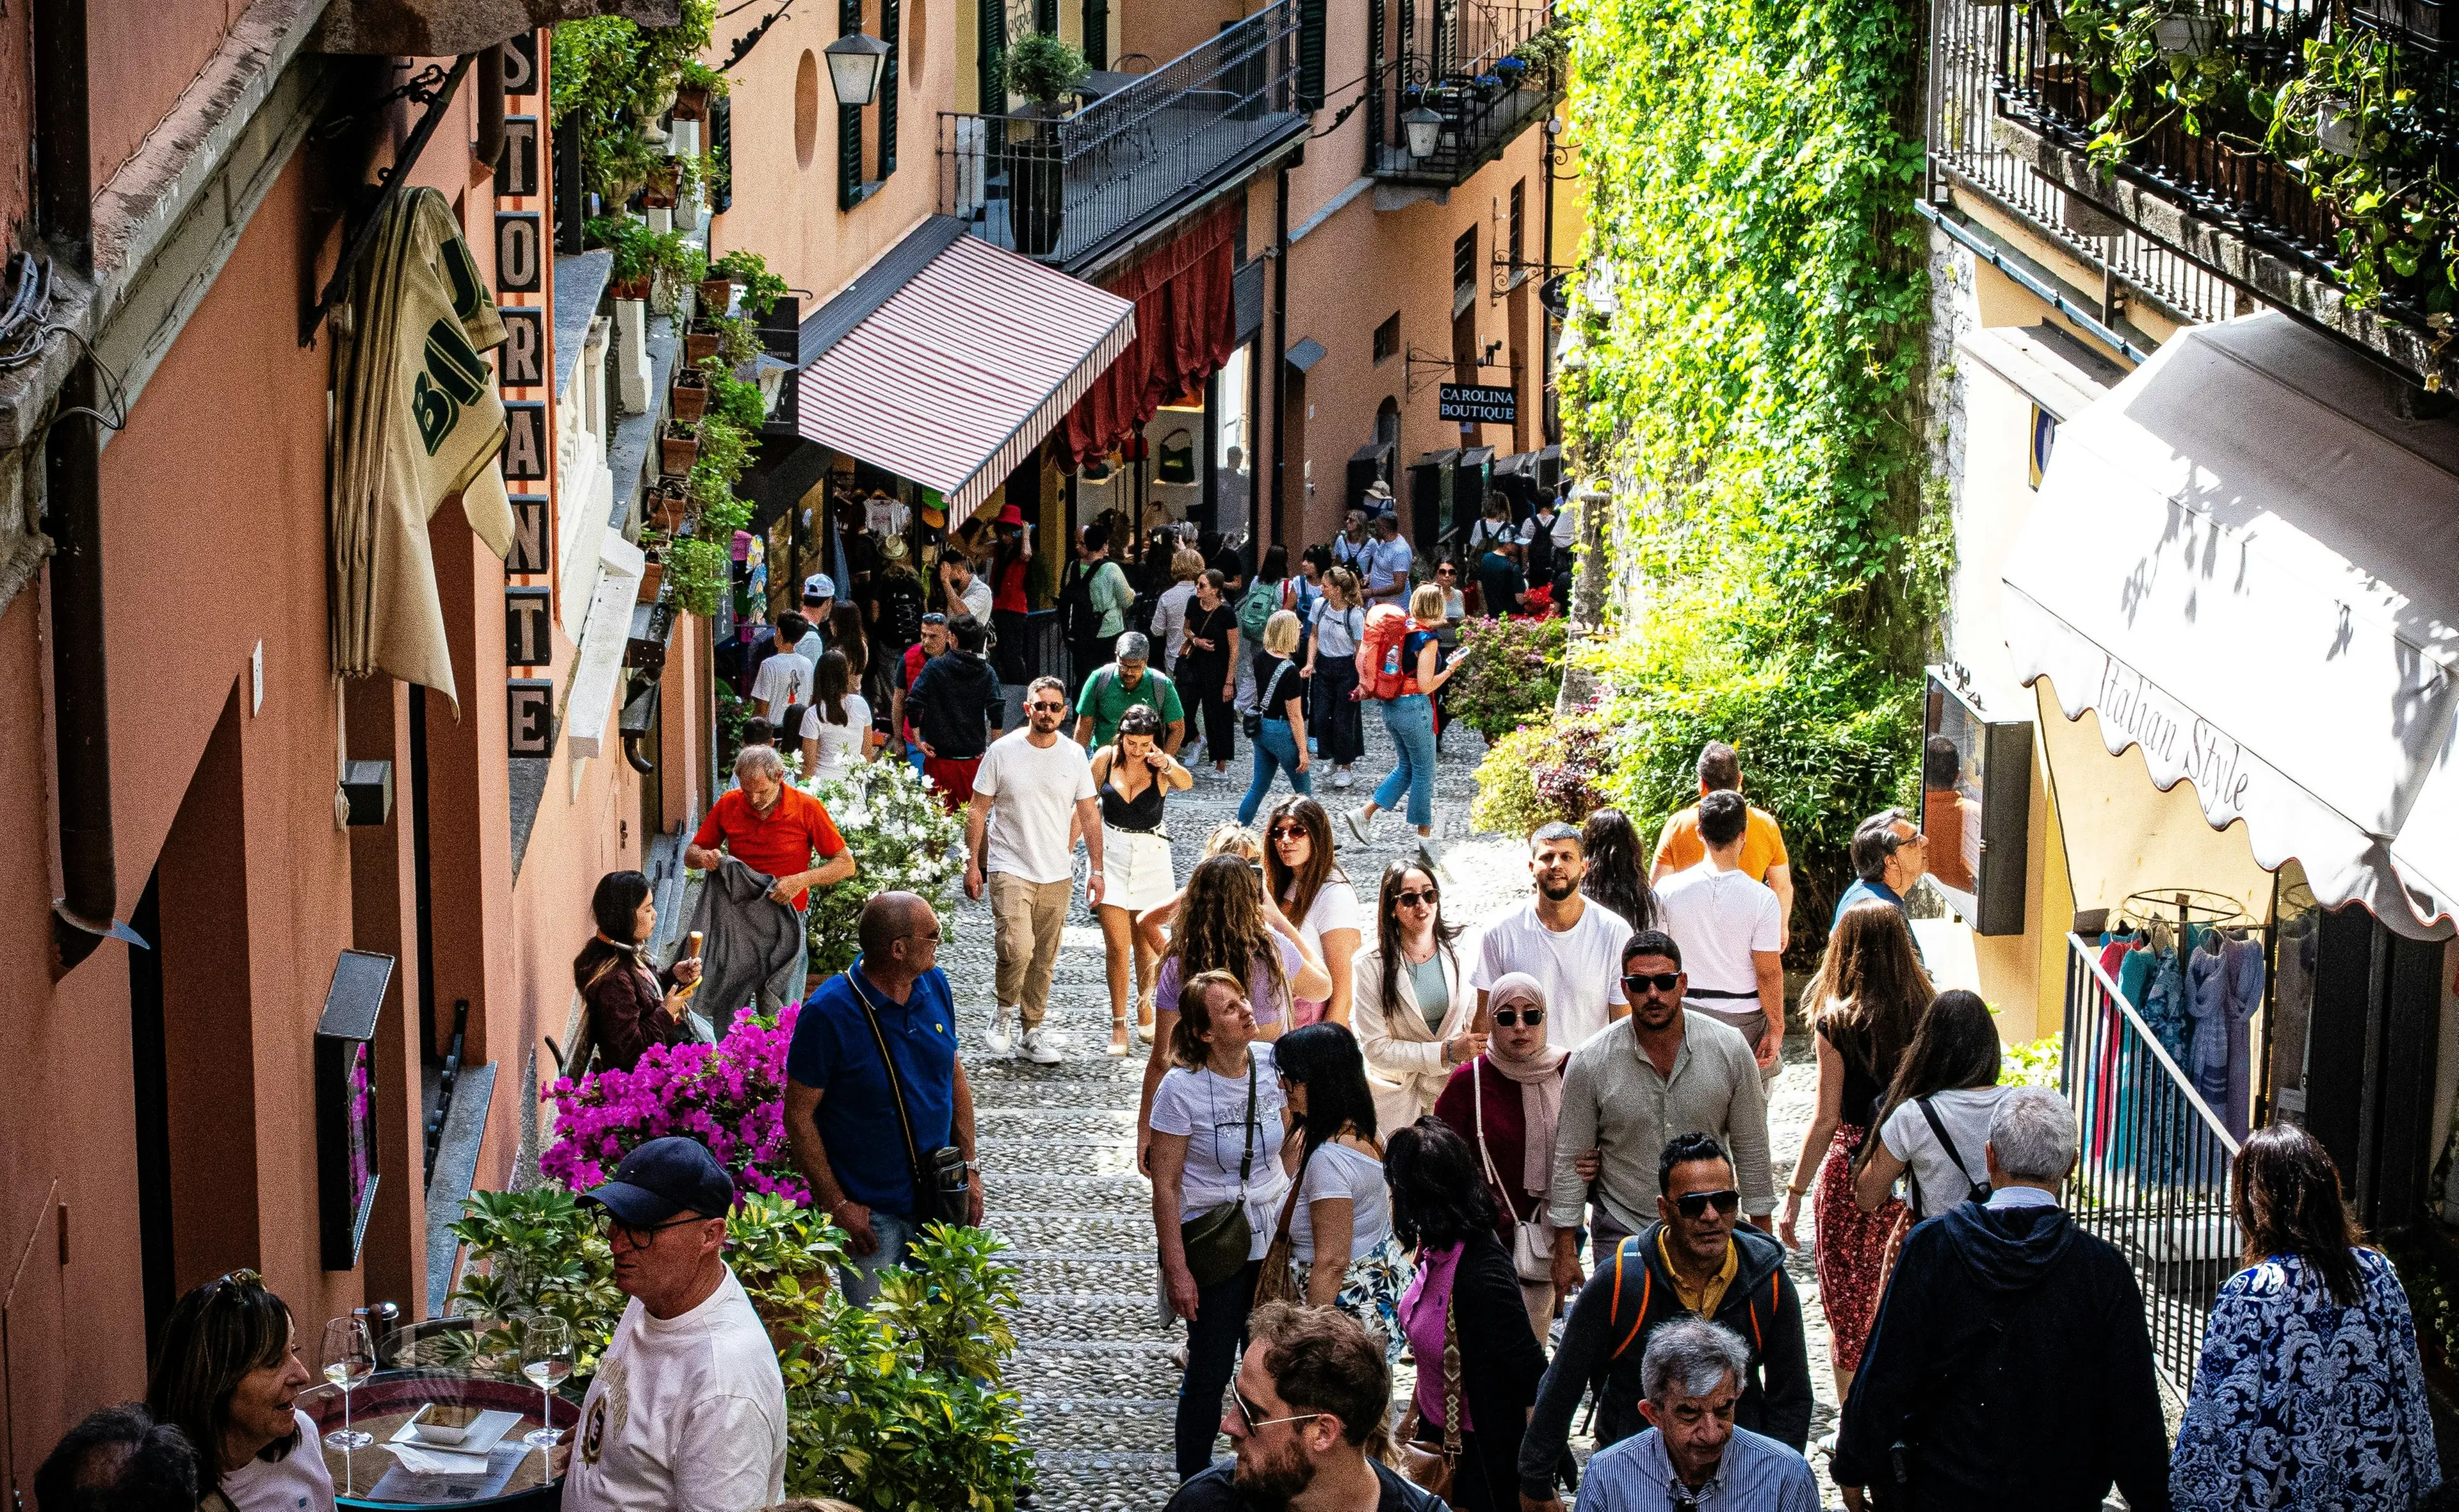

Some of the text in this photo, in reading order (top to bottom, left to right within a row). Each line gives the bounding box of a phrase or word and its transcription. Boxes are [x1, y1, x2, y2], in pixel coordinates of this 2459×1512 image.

[1441, 388, 1514, 404] CAROLINA
[1441, 403, 1514, 421] BOUTIQUE
[2097, 653, 2177, 762] Italian
[2182, 717, 2248, 815] Style
